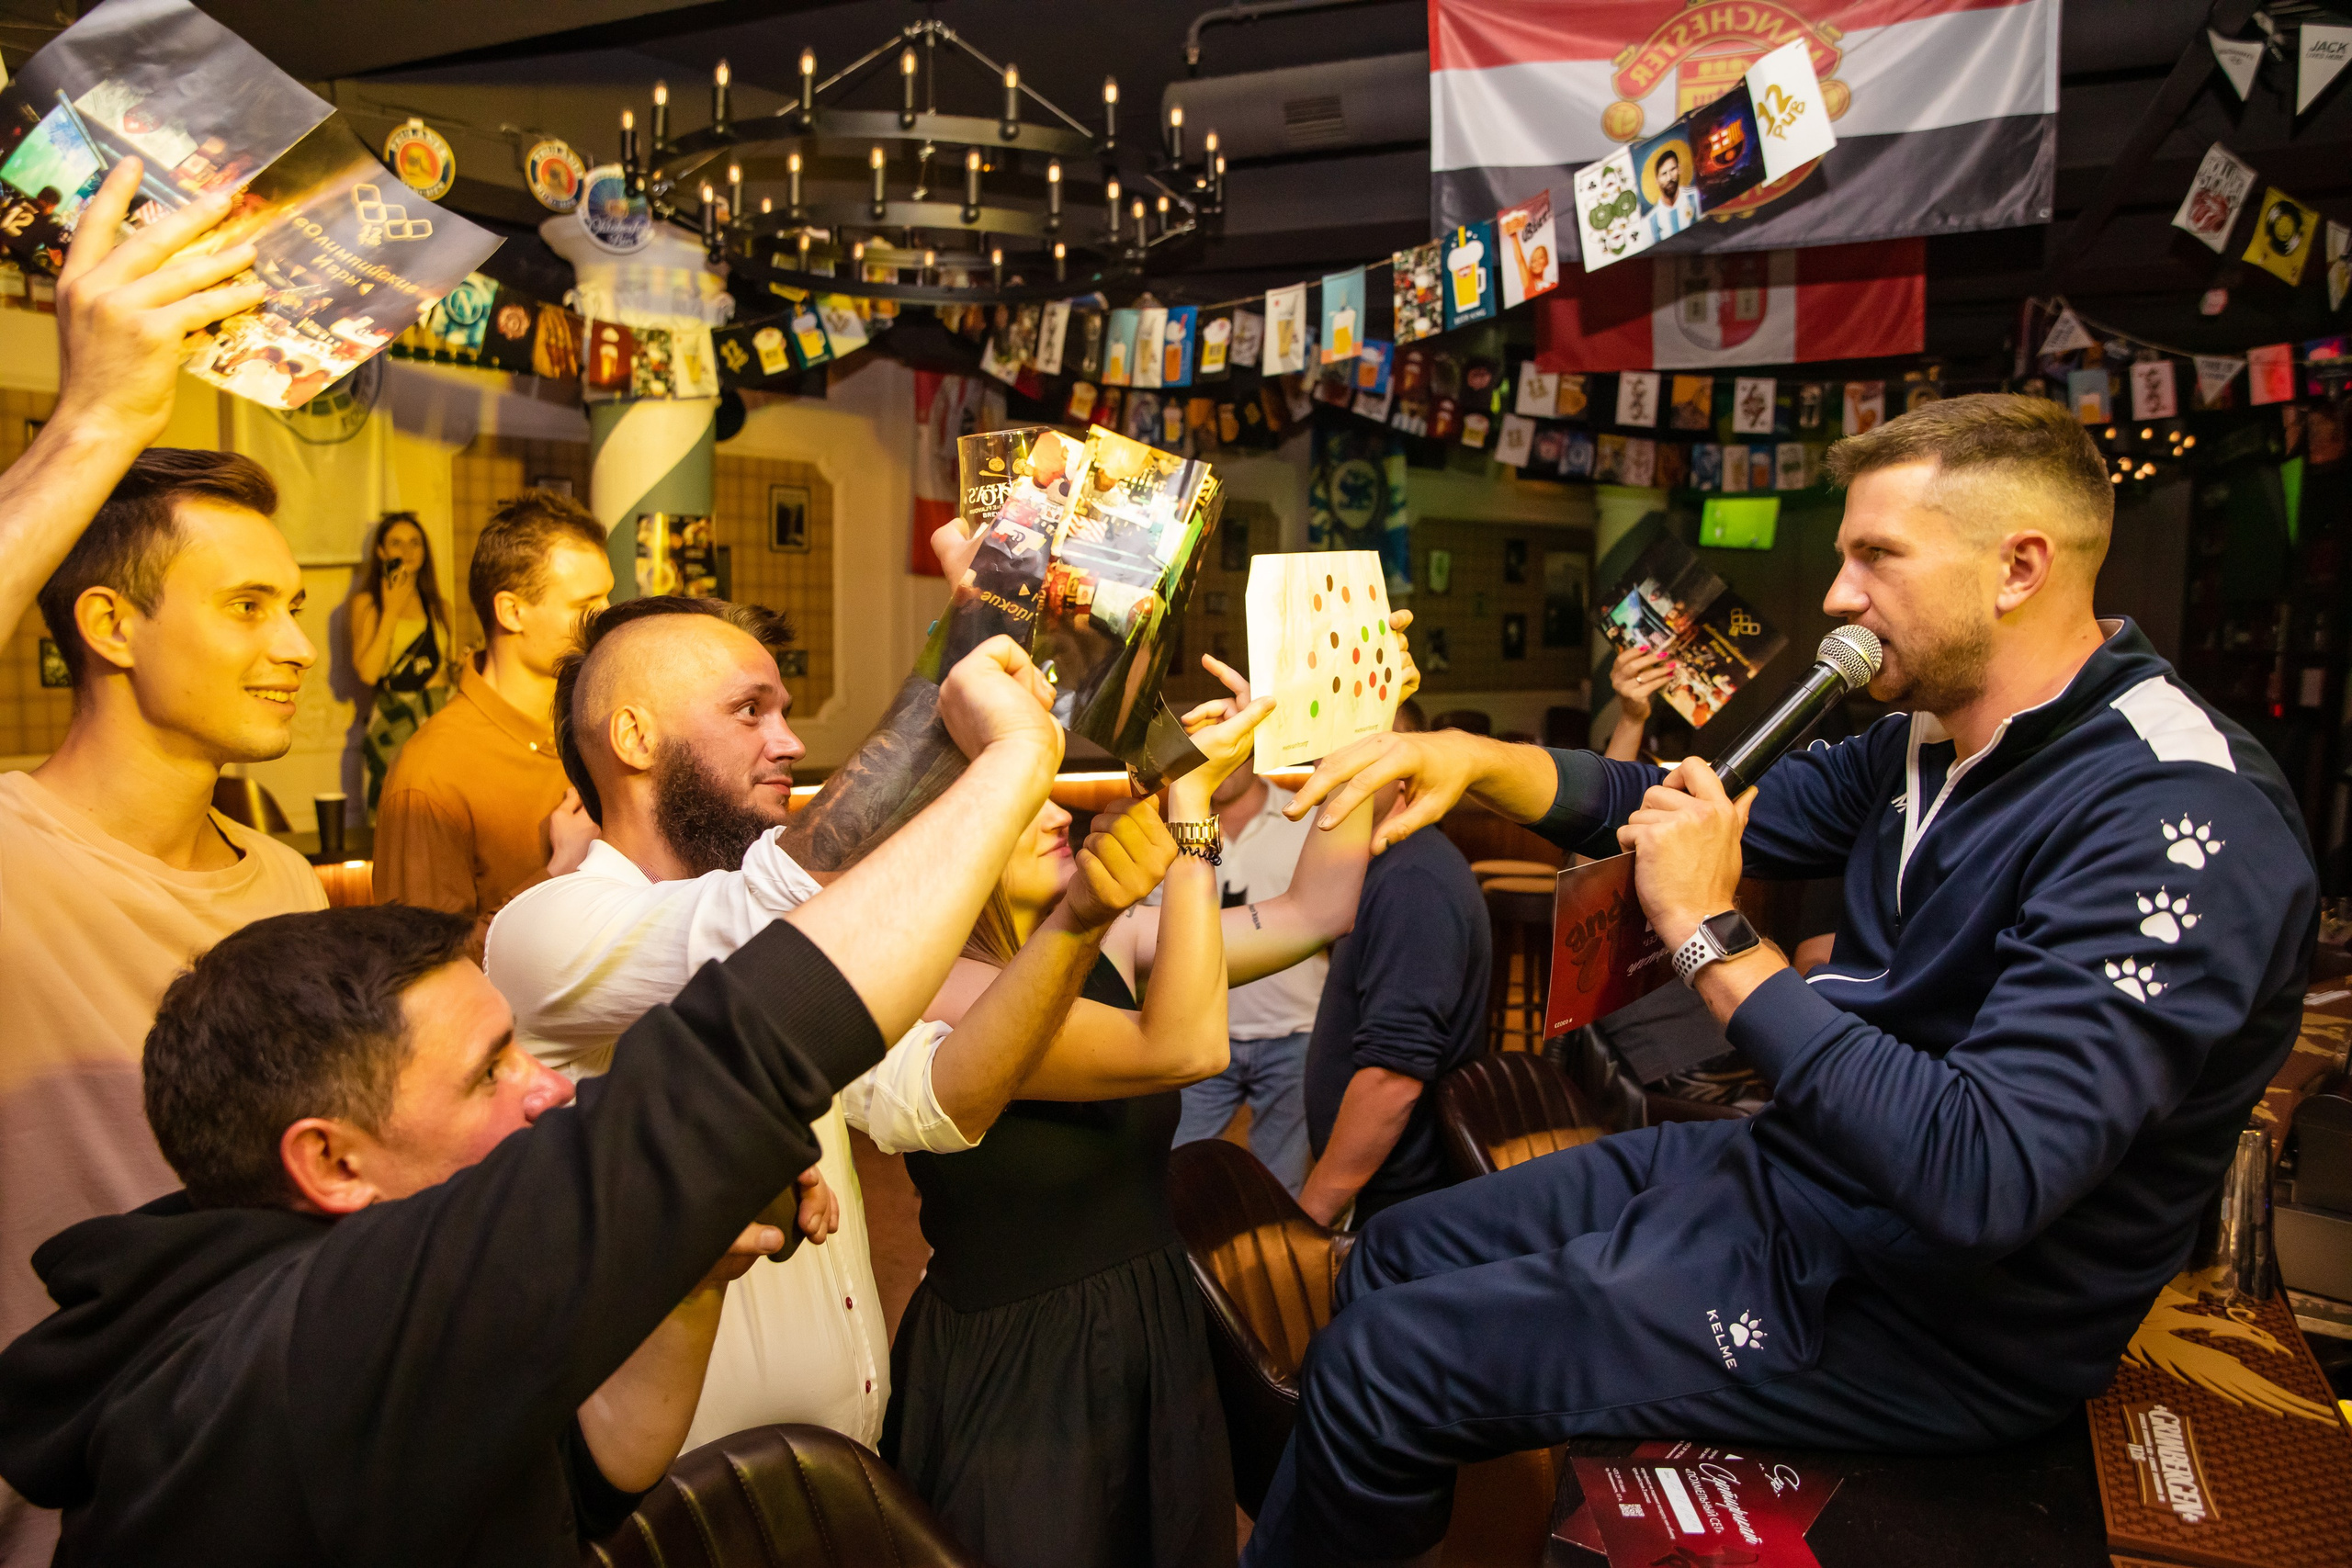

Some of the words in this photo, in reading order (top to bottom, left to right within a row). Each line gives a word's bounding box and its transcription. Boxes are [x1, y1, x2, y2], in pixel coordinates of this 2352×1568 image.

[2310, 40, 2349, 53] JACK
[1757, 84, 1793, 137] 12
[311, 254, 362, 288] Игры
[1706, 1309, 1737, 1370] KELME
[1699, 1462, 1763, 1545] Сертификат
